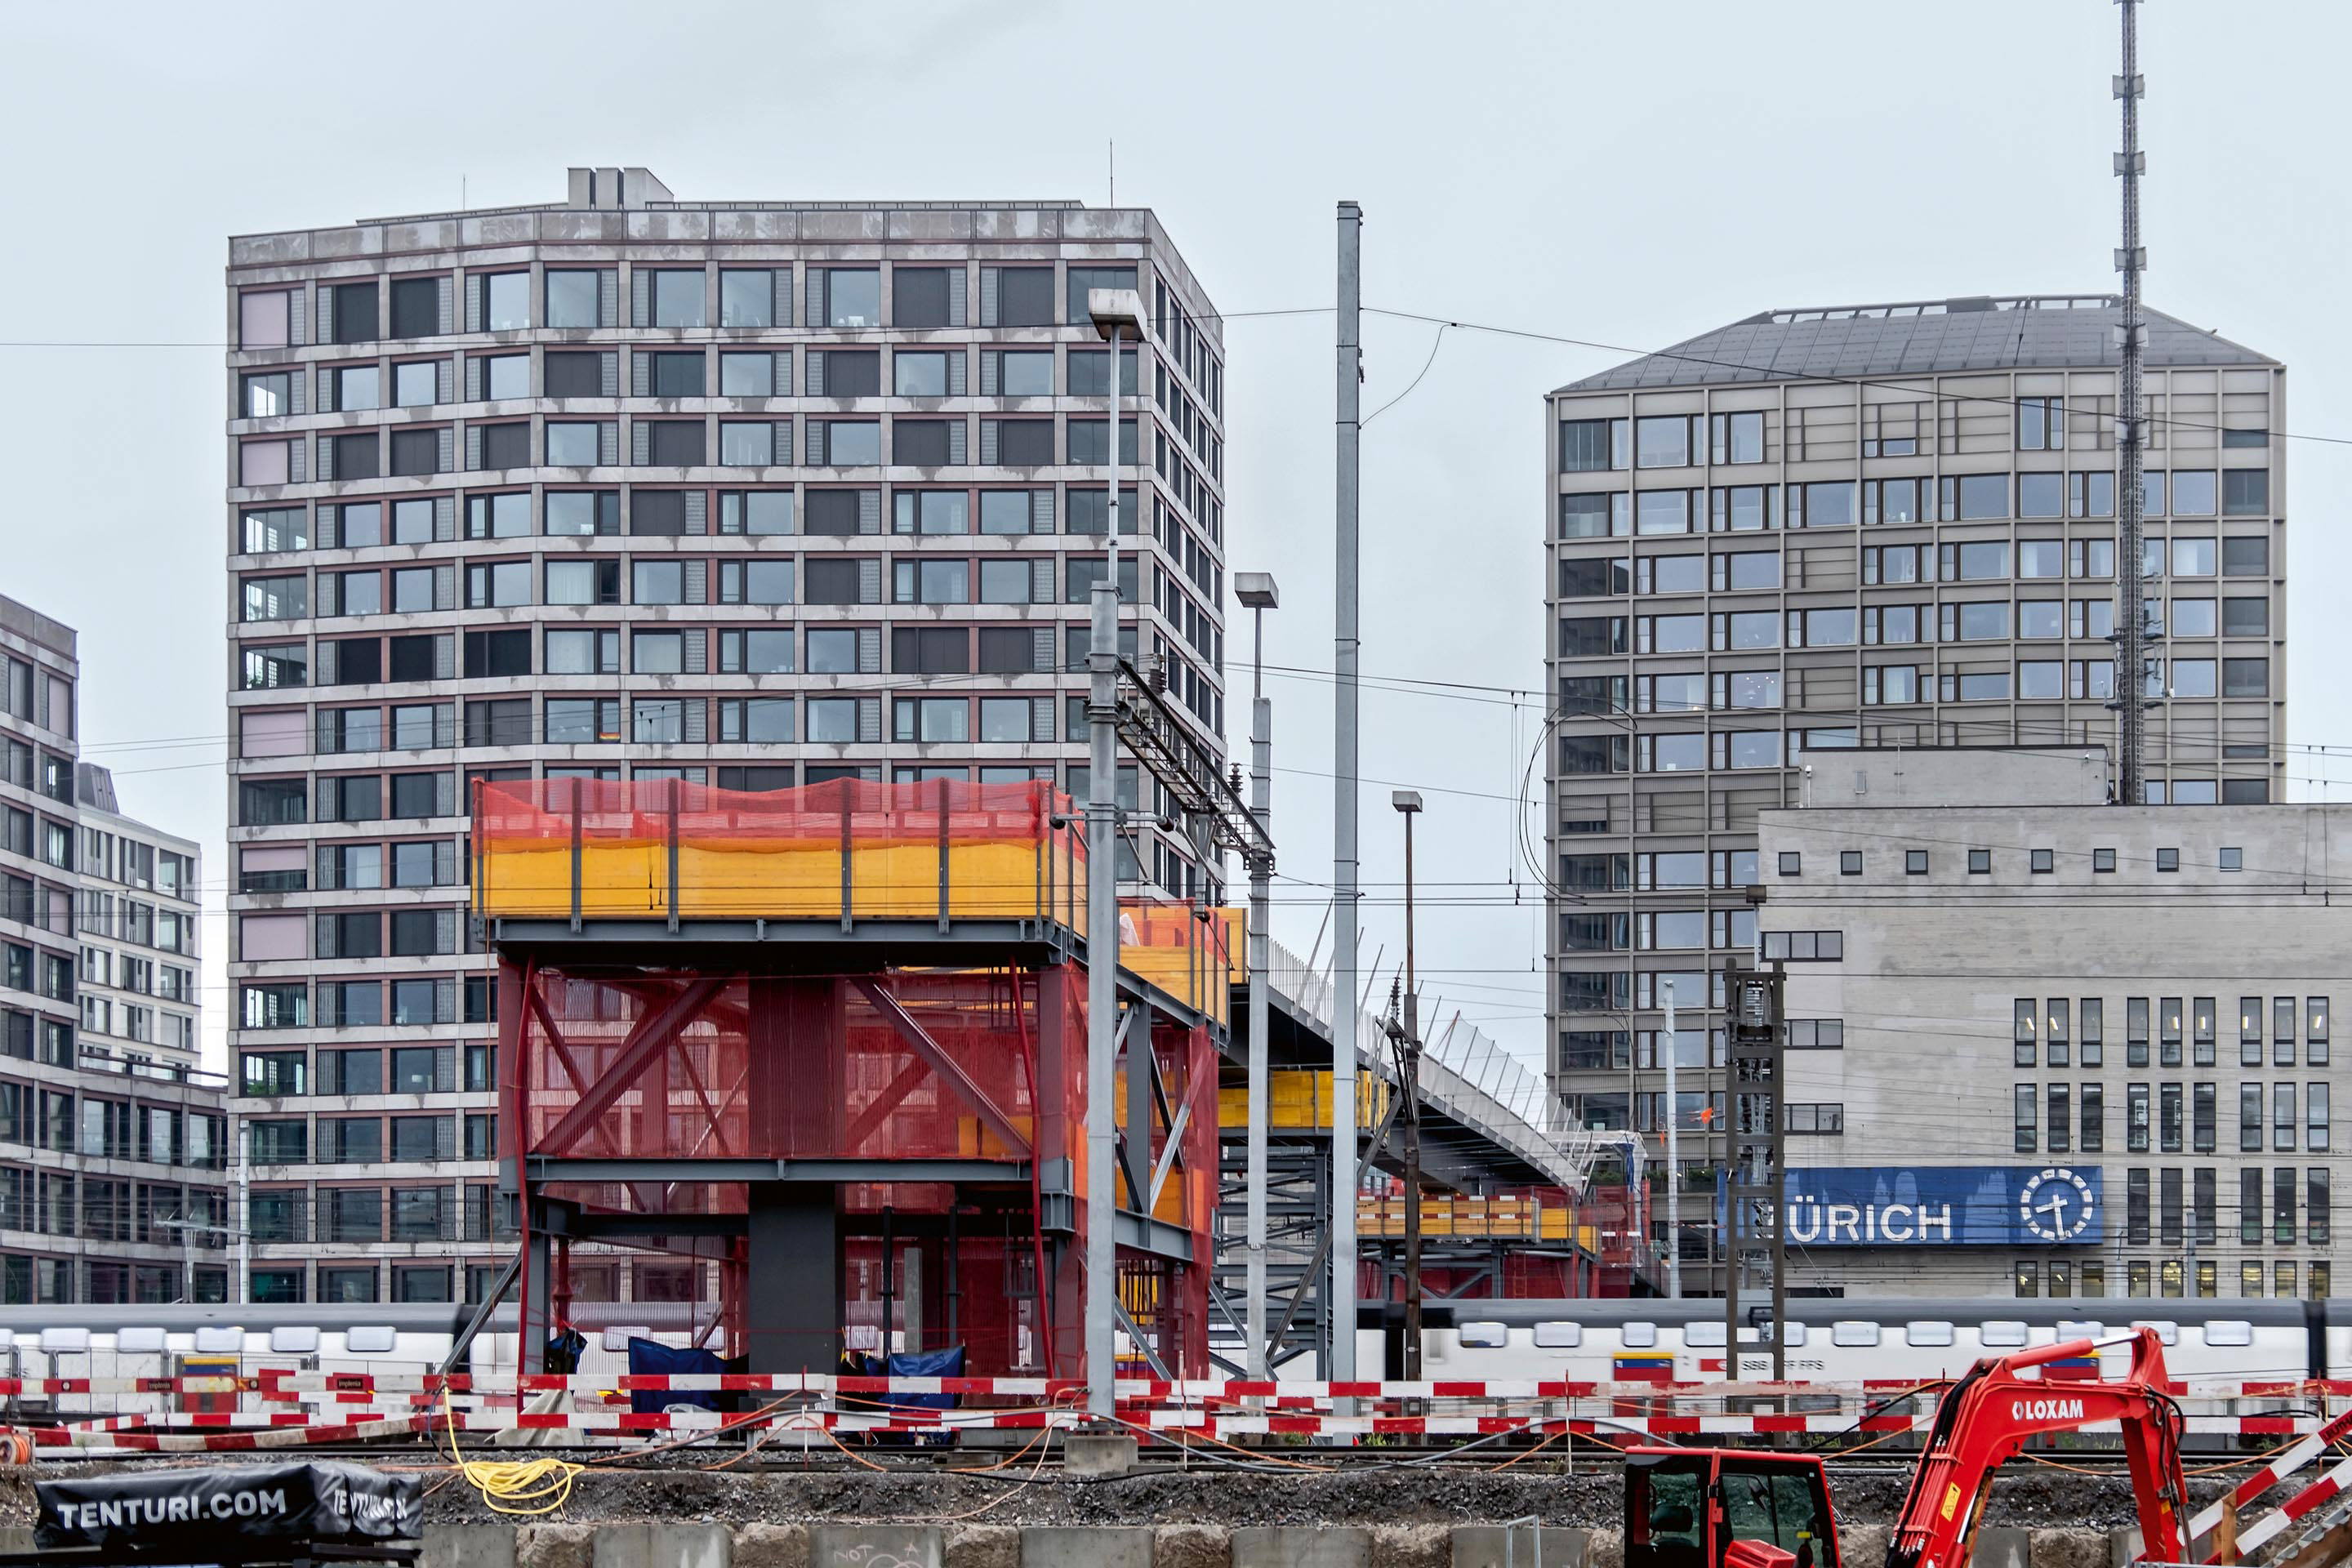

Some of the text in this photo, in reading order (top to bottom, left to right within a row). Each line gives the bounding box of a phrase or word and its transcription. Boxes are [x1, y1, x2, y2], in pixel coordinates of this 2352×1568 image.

[2025, 1399, 2084, 1420] LOXAM
[56, 1489, 287, 1529] TENTURI.COM
[833, 1544, 875, 1564] NOT
